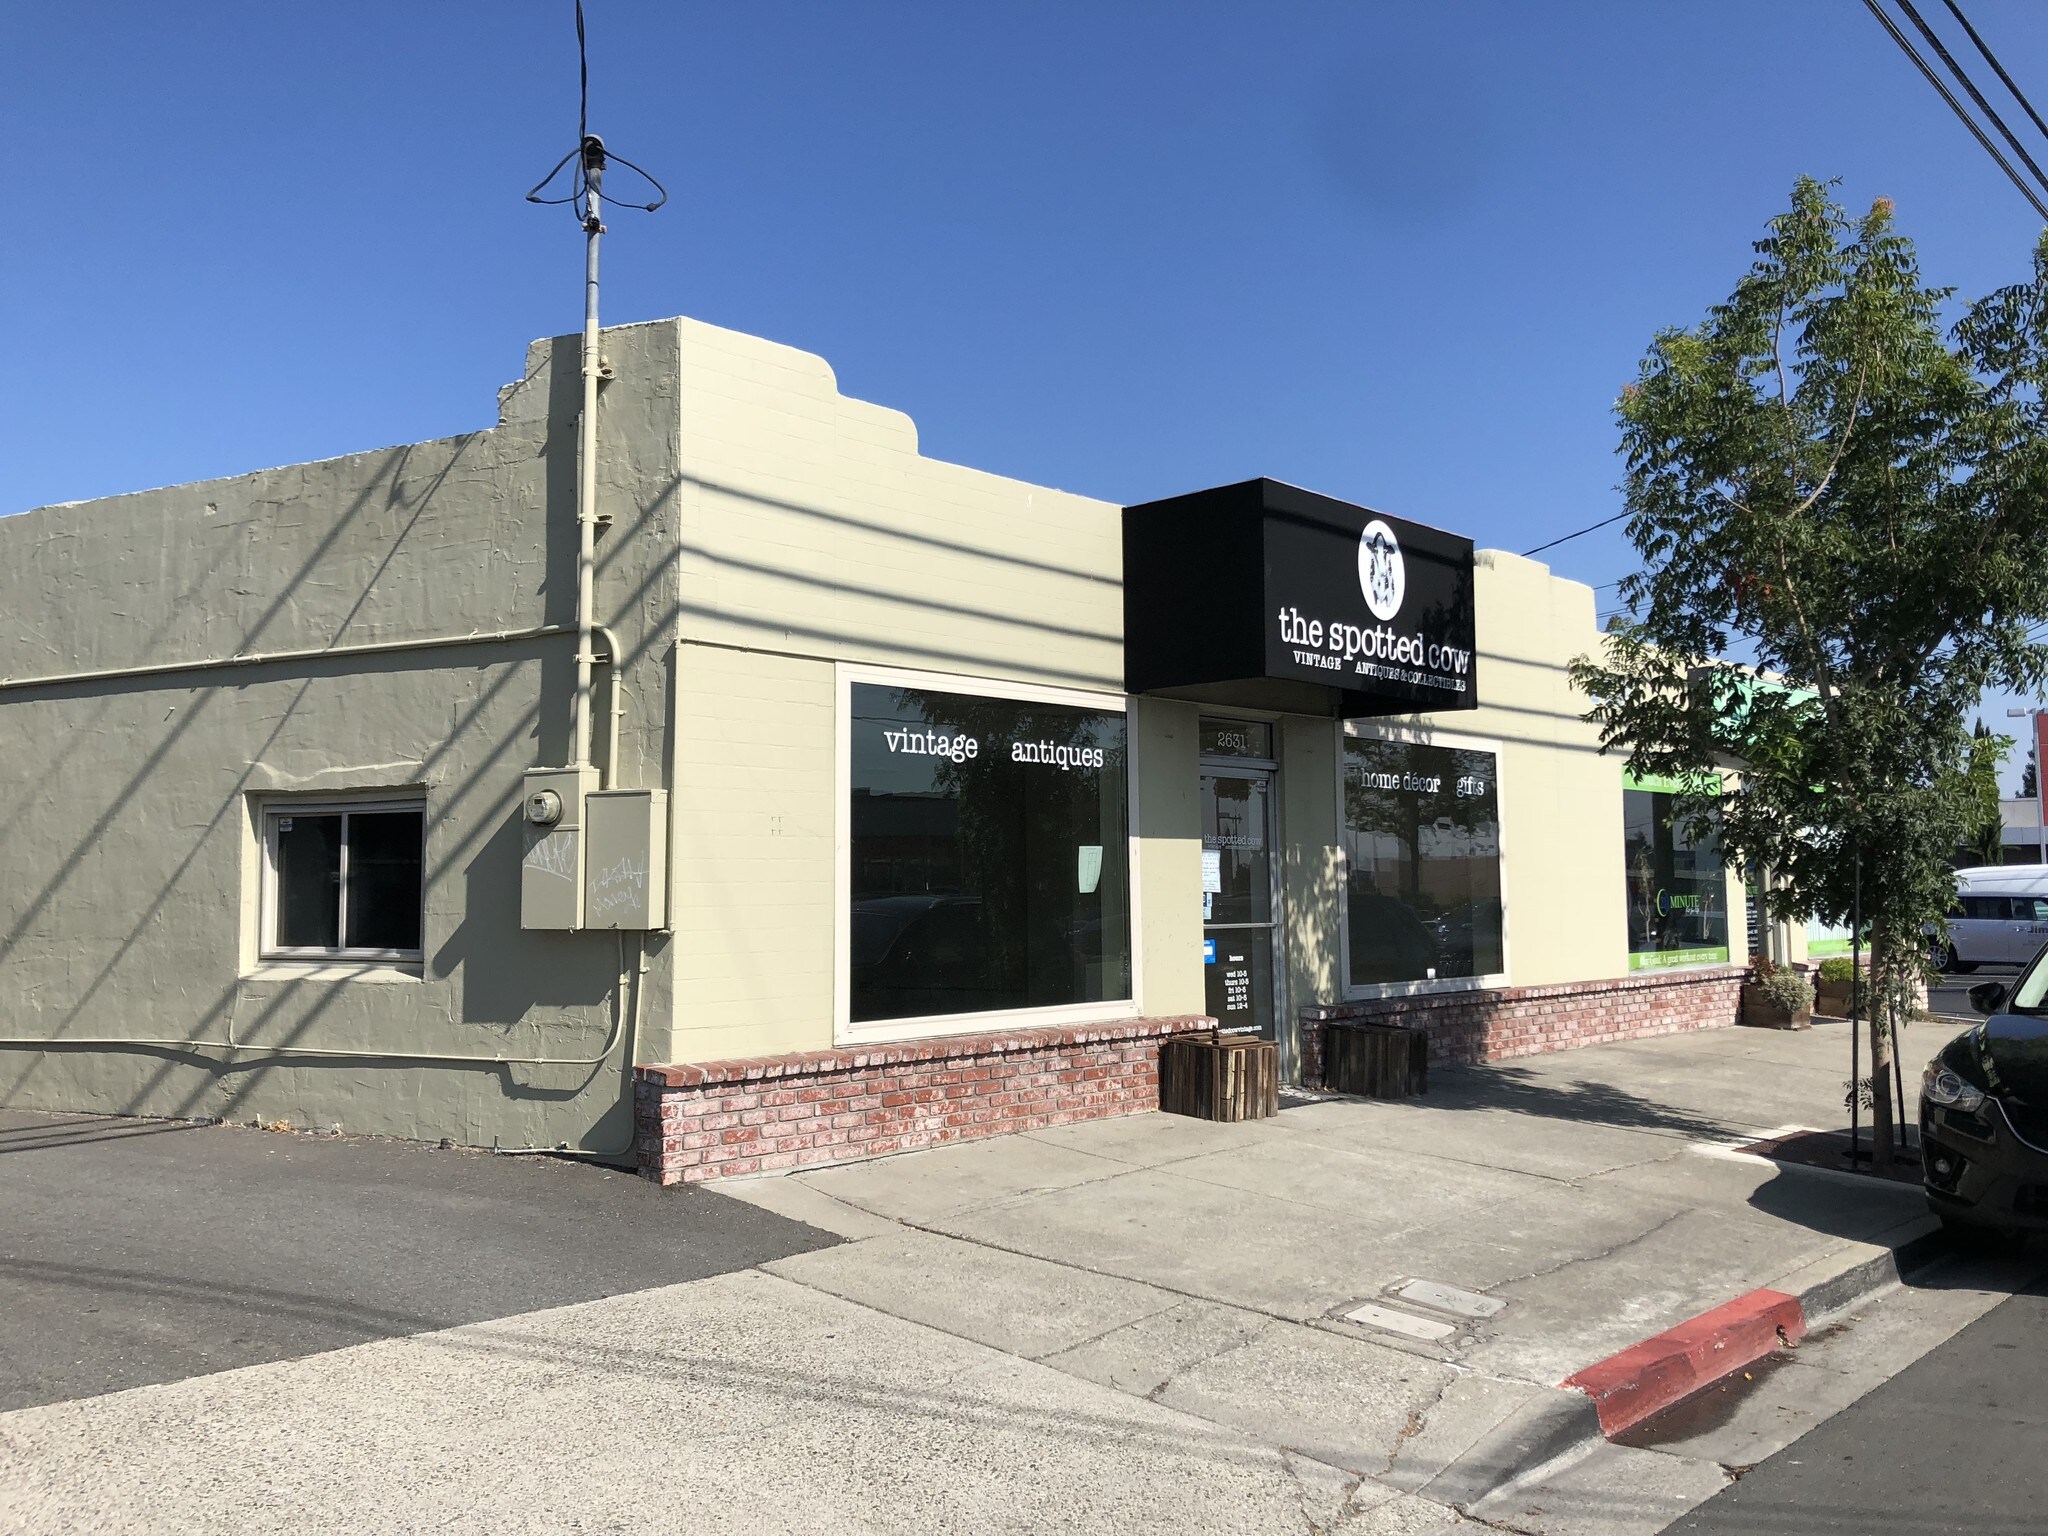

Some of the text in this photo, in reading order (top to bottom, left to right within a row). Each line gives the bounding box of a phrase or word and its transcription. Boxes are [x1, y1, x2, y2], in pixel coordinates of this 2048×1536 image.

[1278, 606, 1471, 675] the spotted cow
[1293, 650, 1342, 671] VINTAGE
[1355, 661, 1400, 681] ANTIQUES
[1407, 671, 1467, 693] COLLECTIBLES
[884, 727, 1105, 771] vintage antiques
[1217, 731, 1246, 750] 2631
[1361, 767, 1485, 798] home décor gifts
[1204, 834, 1217, 845] the
[1217, 834, 1247, 847] spotted
[1247, 837, 1262, 846] cow
[1669, 894, 1700, 909] MINUTE
